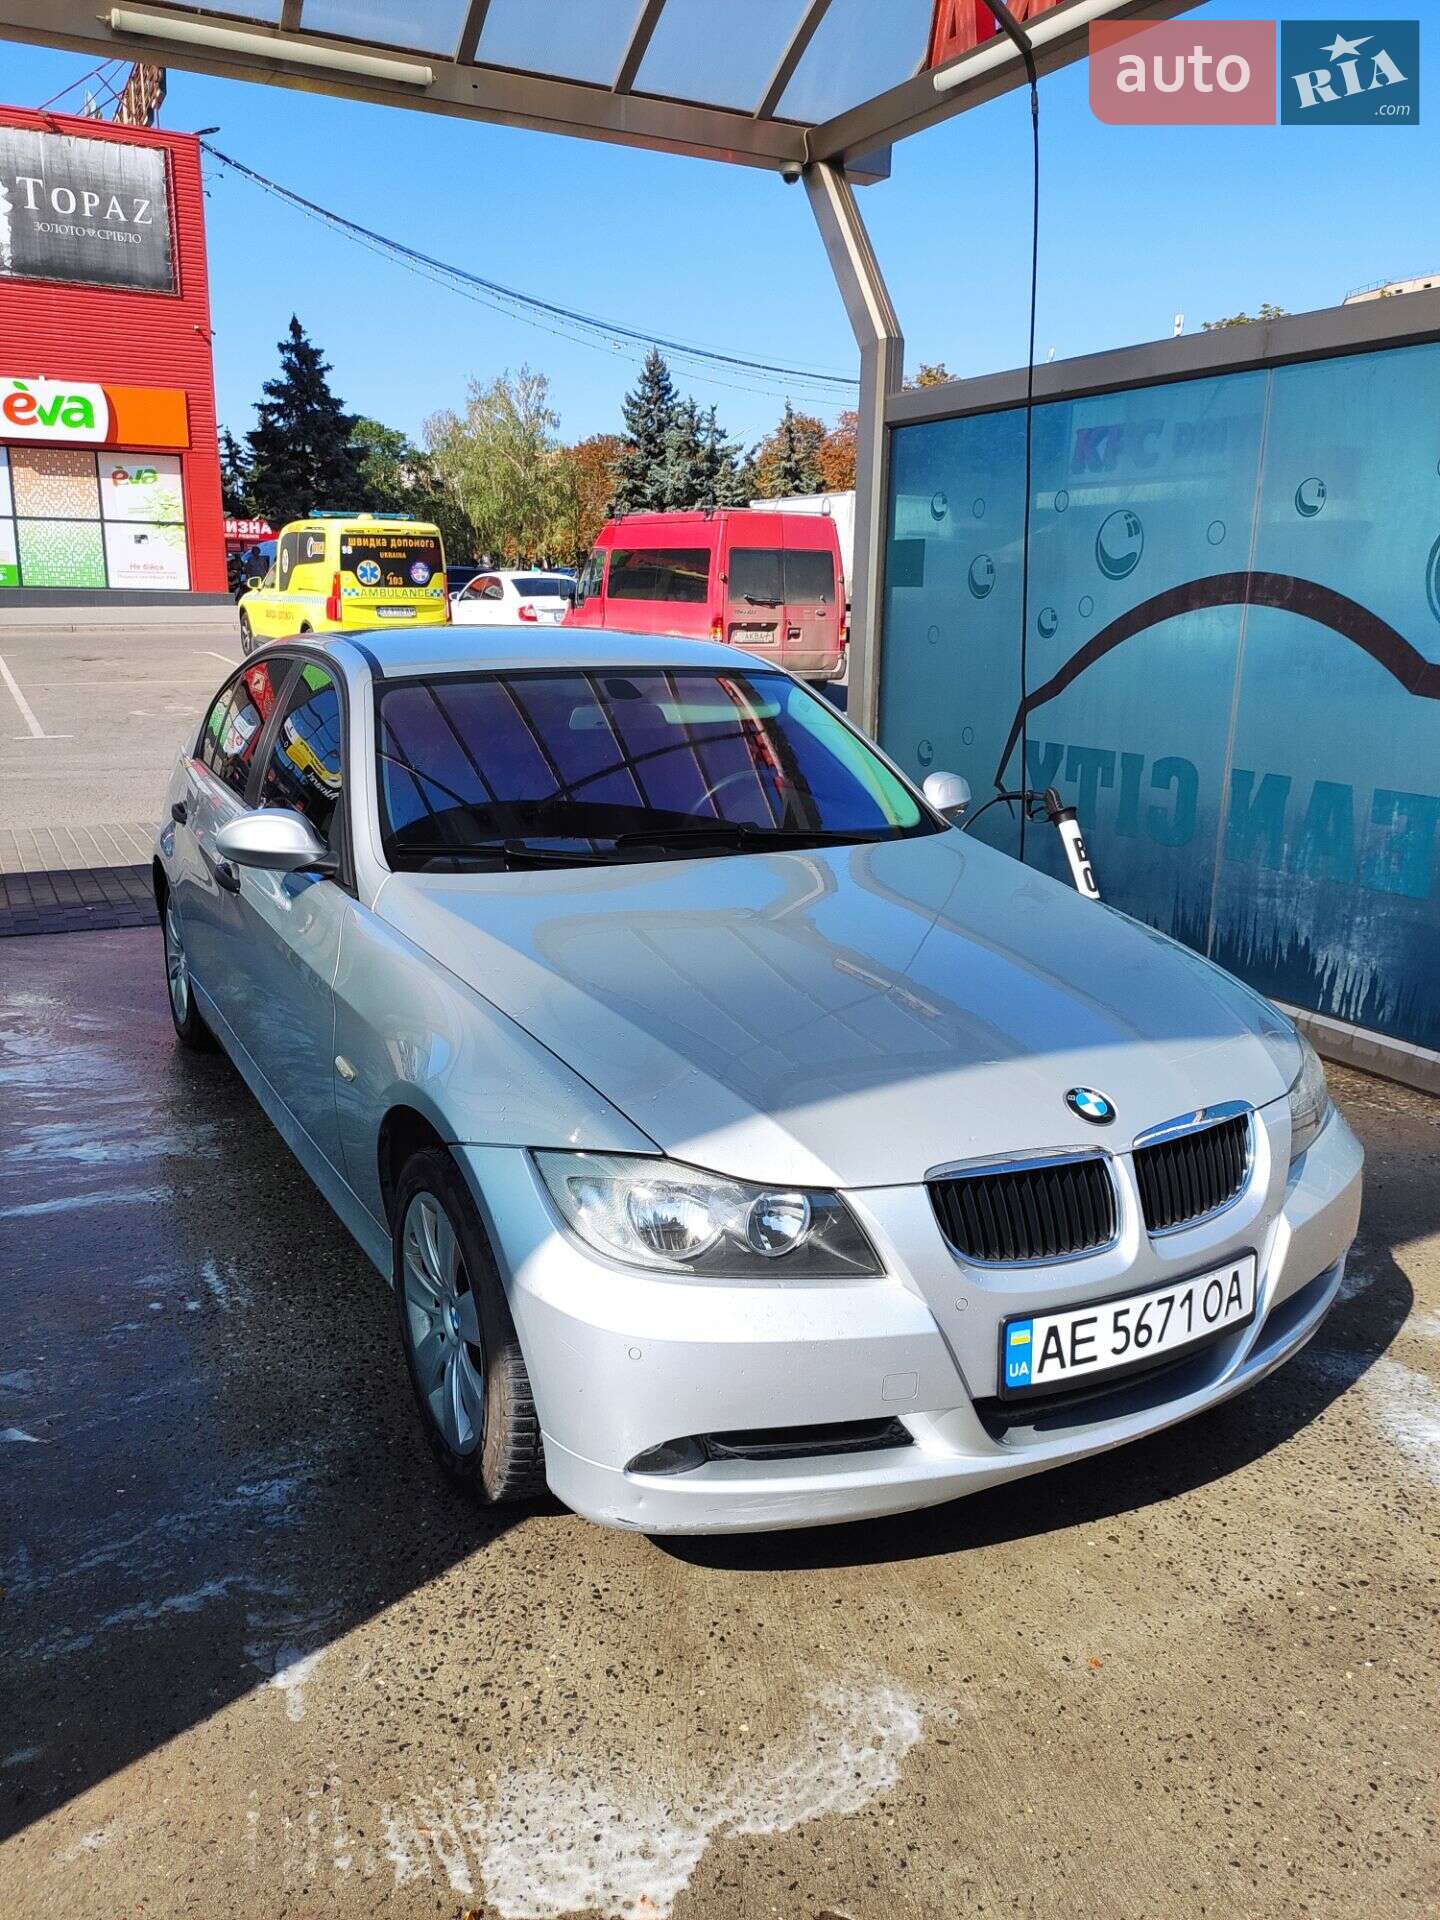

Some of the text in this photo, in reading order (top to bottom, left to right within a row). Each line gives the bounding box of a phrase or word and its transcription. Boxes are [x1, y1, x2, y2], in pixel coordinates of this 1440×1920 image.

[16, 176, 153, 225] TOPAZ
[360, 588, 432, 598] AMBULANCE
[1036, 1270, 1243, 1374] AE 5671 OA
[1009, 1364, 1030, 1379] UA
